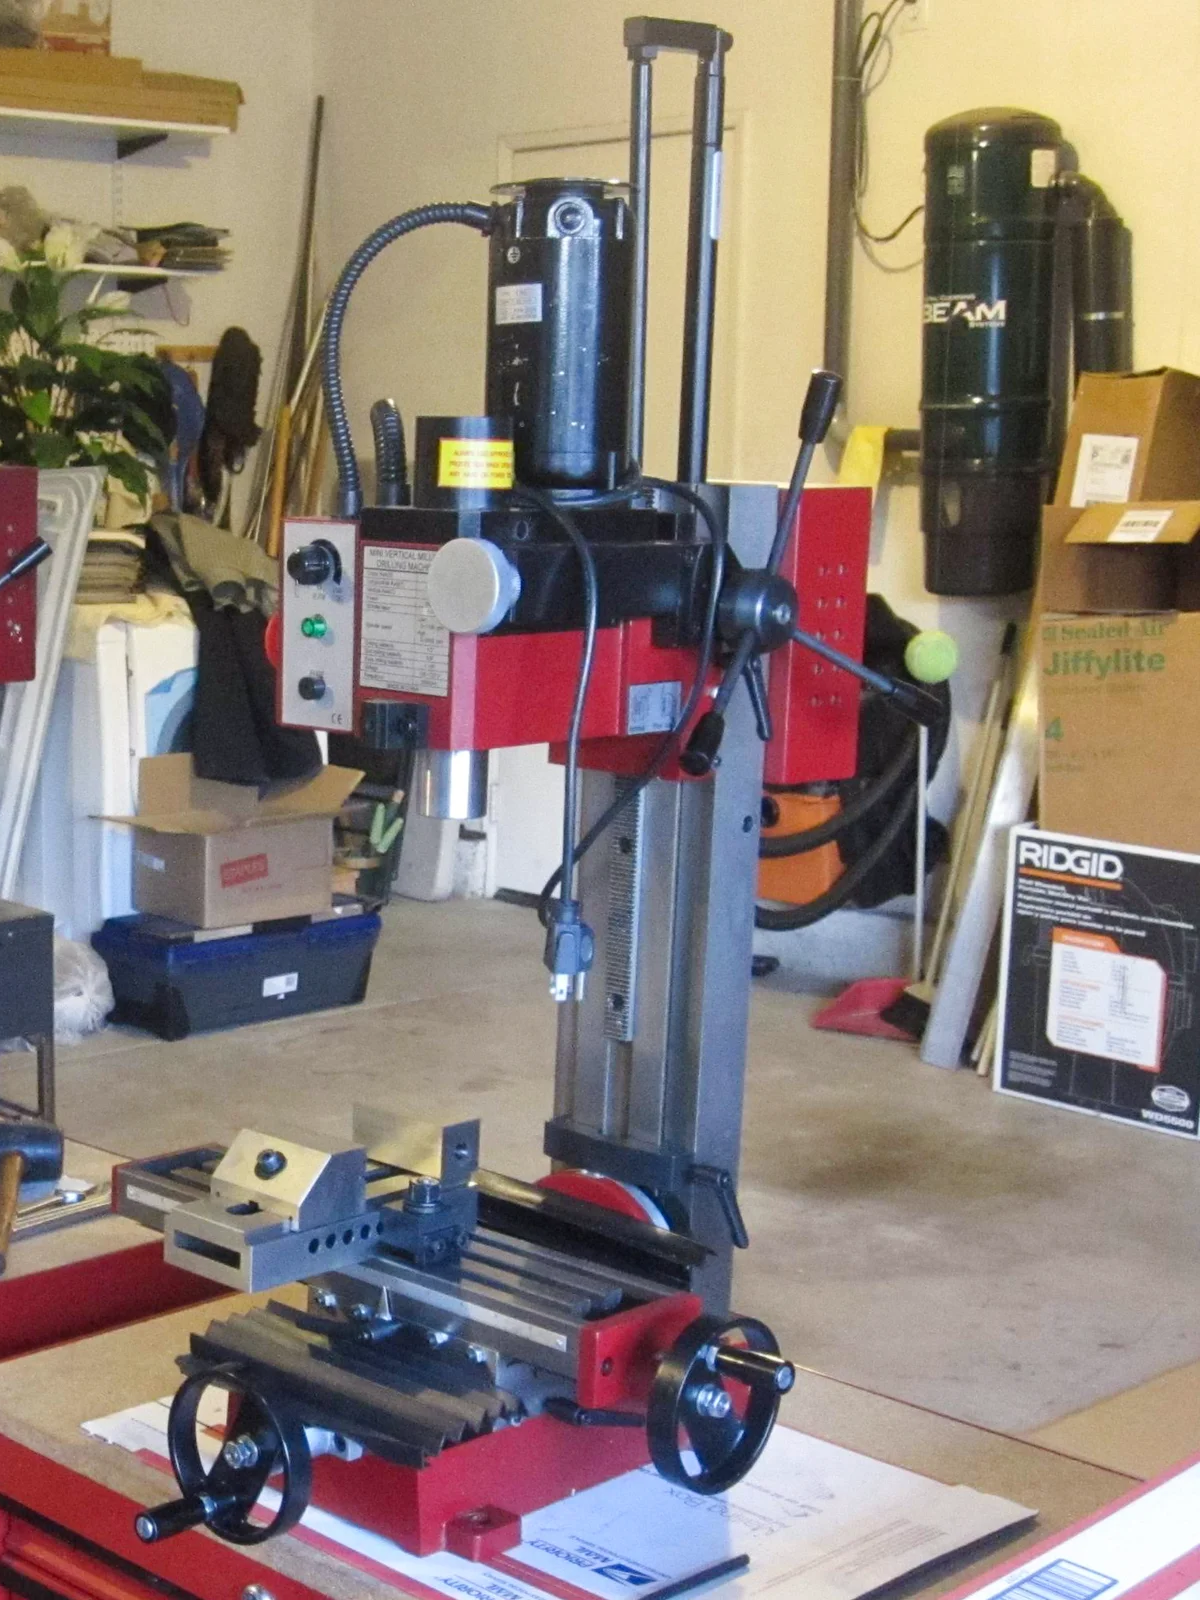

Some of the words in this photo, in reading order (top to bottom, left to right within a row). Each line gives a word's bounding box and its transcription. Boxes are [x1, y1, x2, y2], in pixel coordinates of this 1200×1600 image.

[923, 300, 1007, 323] BEAM
[376, 559, 408, 571] DRILLING
[385, 551, 417, 561] VERTICAL
[1043, 649, 1166, 680] Jiffylite
[1019, 840, 1125, 881] RIDGID
[525, 1538, 599, 1569] PRIORITY
[574, 1545, 614, 1563] MAIL
